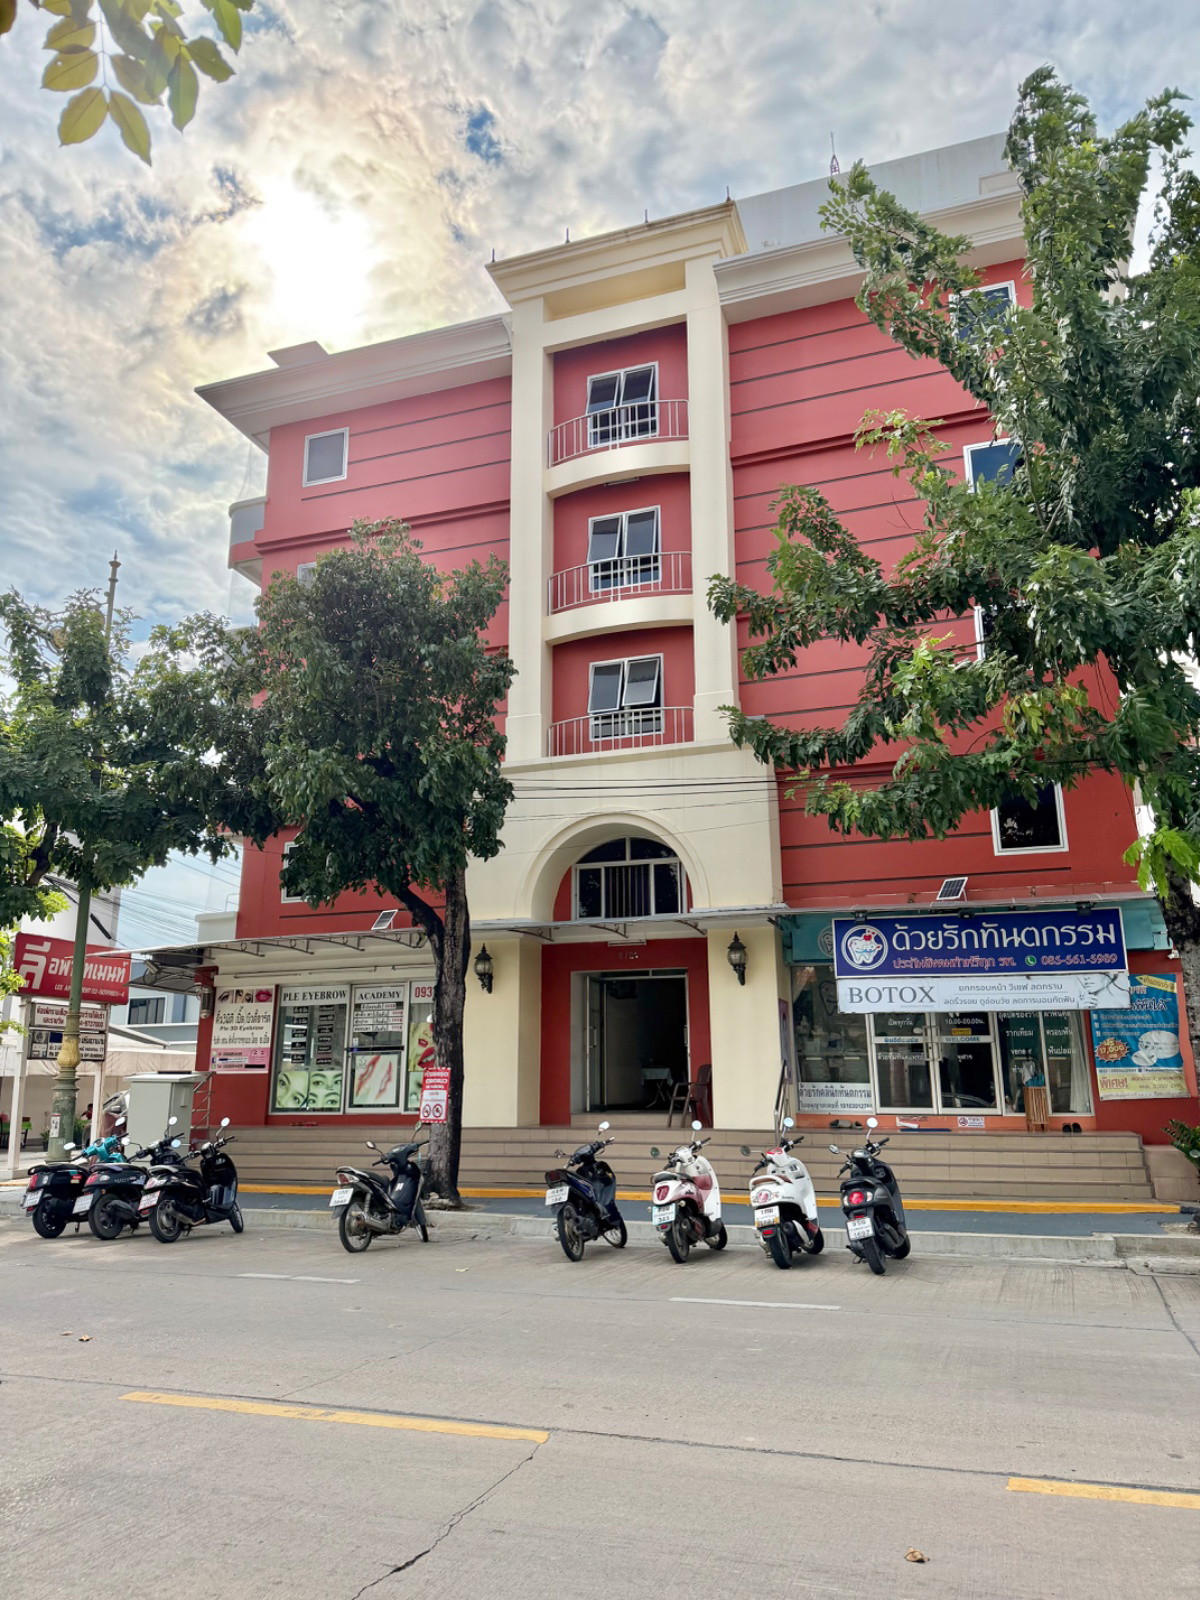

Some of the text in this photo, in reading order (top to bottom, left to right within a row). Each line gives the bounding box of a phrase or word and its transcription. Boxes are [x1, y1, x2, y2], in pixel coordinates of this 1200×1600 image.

[892, 921, 1117, 951] ด้วยรักทันตกรรม
[958, 983, 1063, 993] ยกกรอบหน้า วีเชฟ ลดกราม
[283, 992, 300, 1001] PLE
[302, 990, 347, 1001] EYEBROW
[358, 990, 401, 1000] ACADEMY
[848, 985, 937, 1004] BOTOX
[943, 995, 978, 1005] ลดริ้วรอย
[1005, 1028, 1034, 1037] รากเทียม
